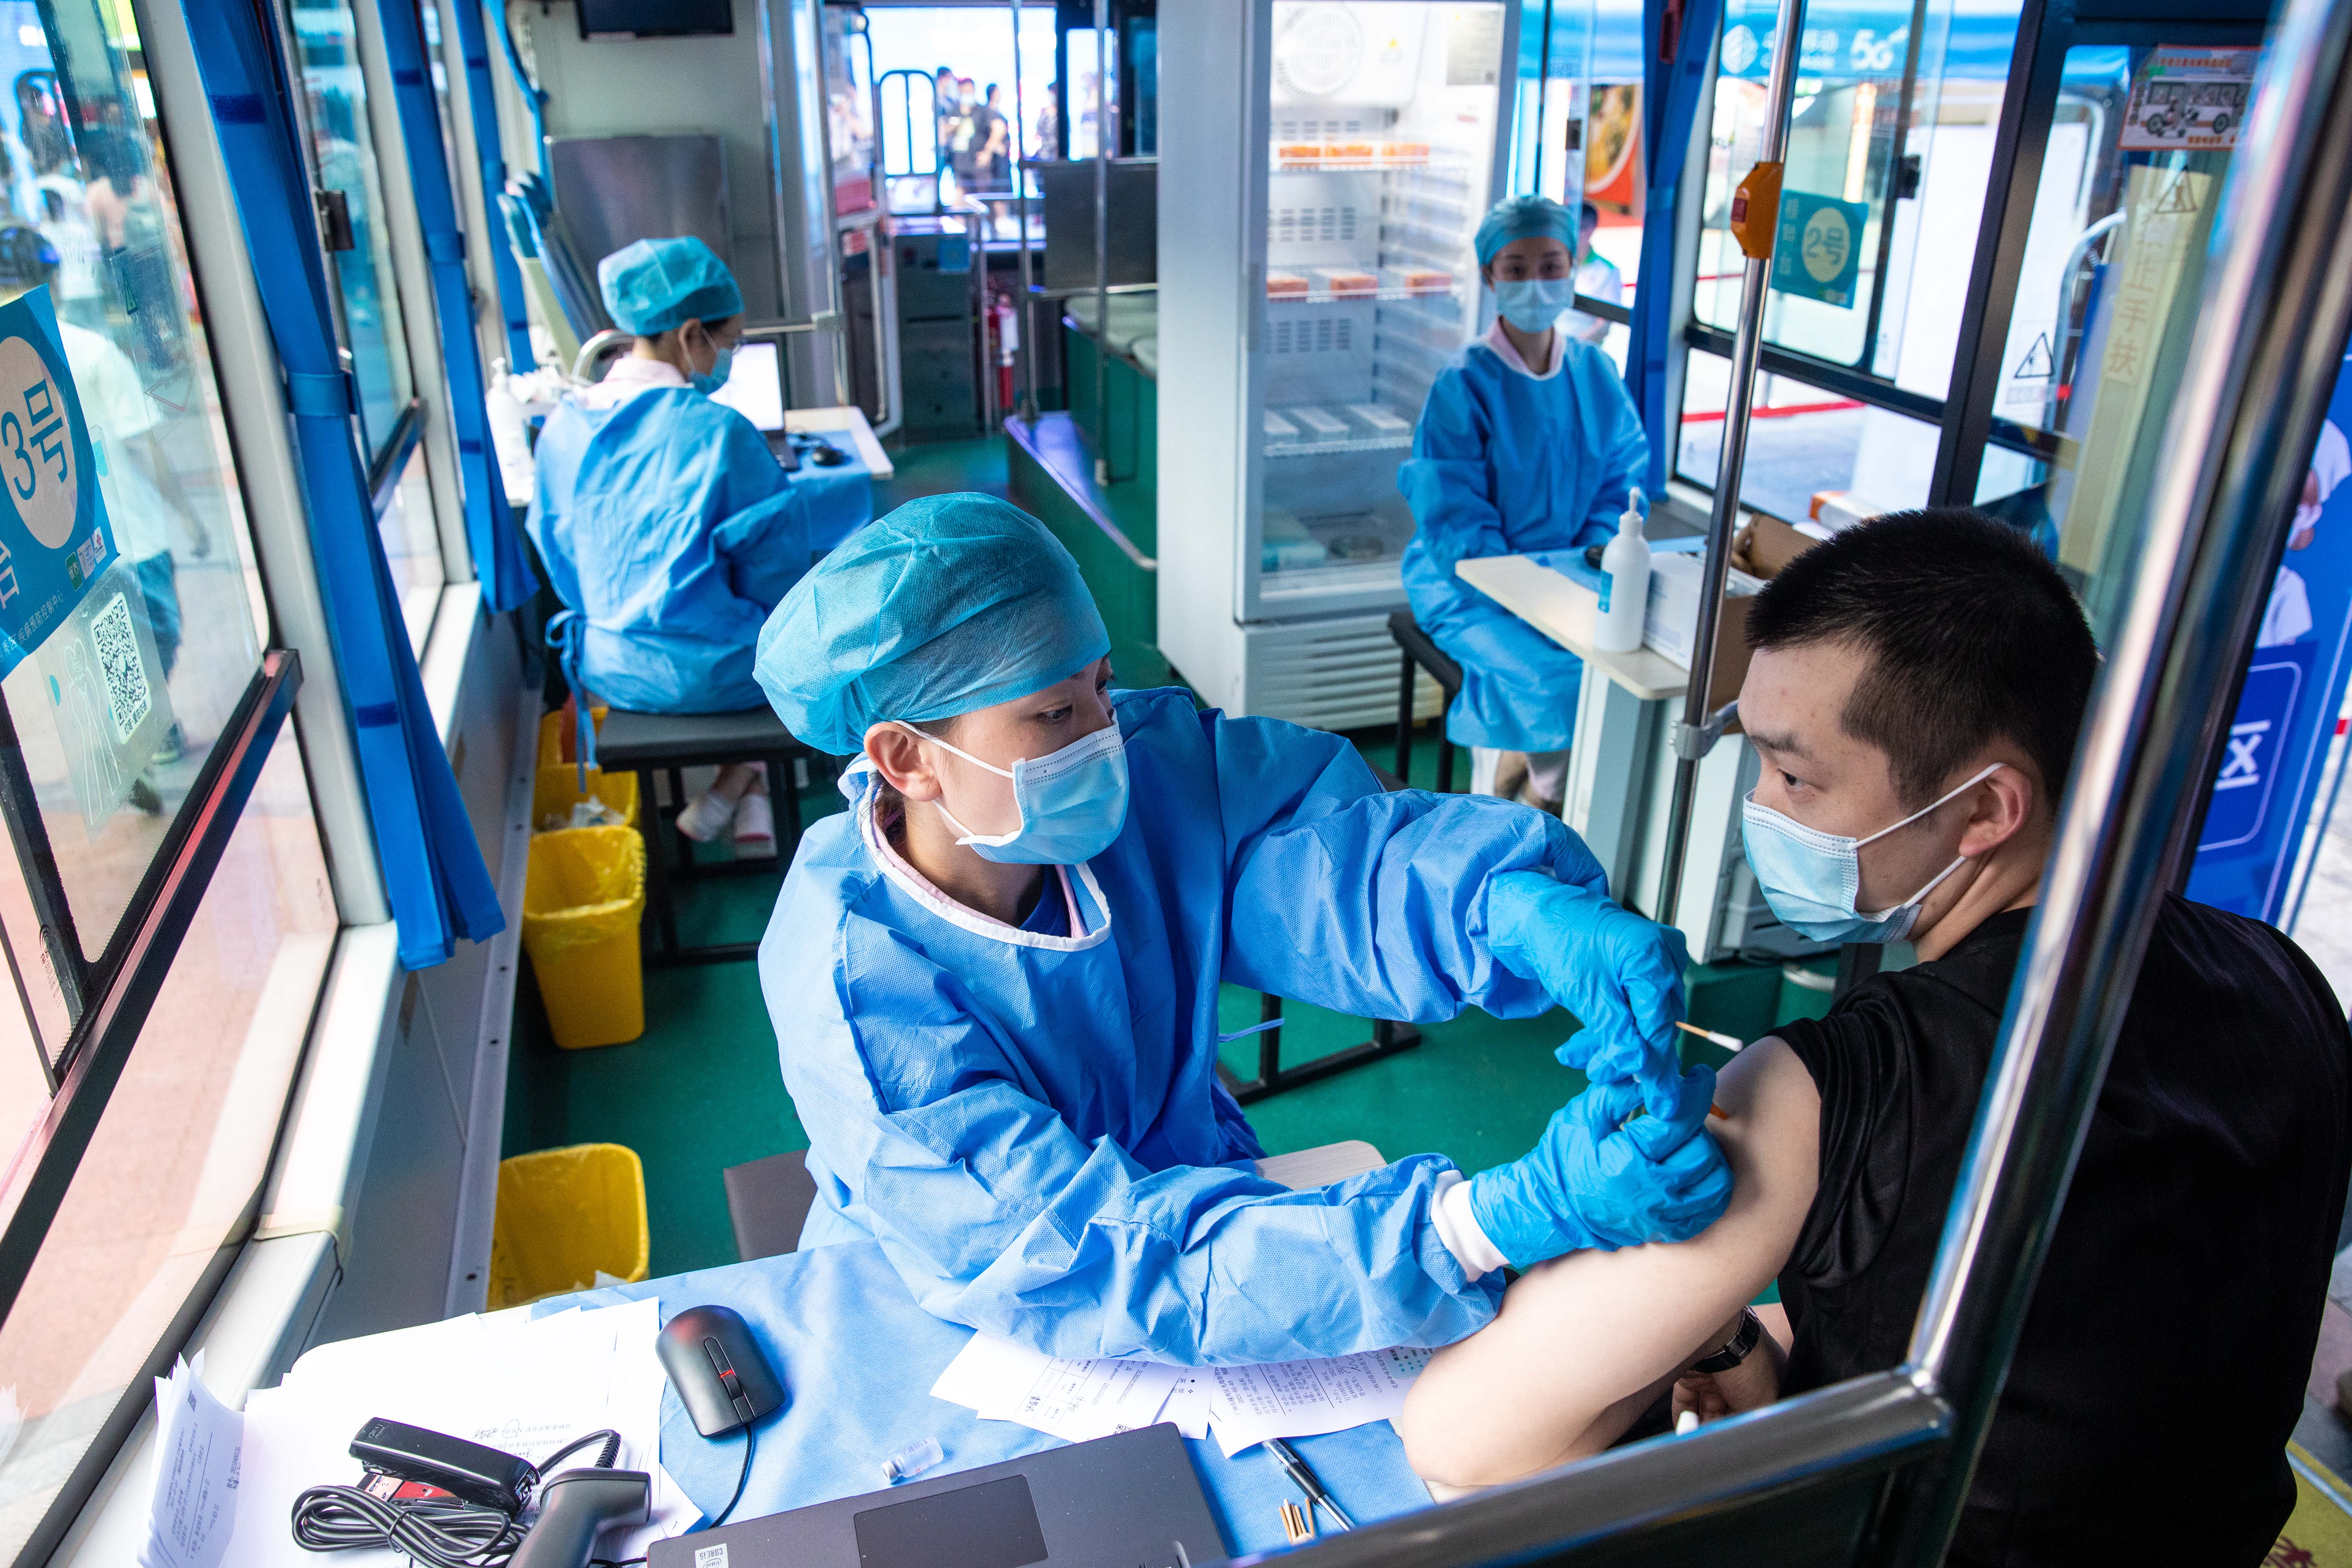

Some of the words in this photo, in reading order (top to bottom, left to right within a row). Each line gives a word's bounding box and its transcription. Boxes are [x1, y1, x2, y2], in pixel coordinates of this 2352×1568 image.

[2, 378, 67, 500] 3号
[1322, 1357, 1337, 1376] 2021-05-
[1321, 1371, 1333, 1385] 0.00元
[1343, 1378, 1358, 1399] 接种时间:
[1228, 1380, 1244, 1403] 2021-05-03
[1239, 1365, 1271, 1414] 出生日期:1992-03-08(29
[1335, 1380, 1351, 1401] 打印时间:
[706, 1548, 723, 1557] CORE
